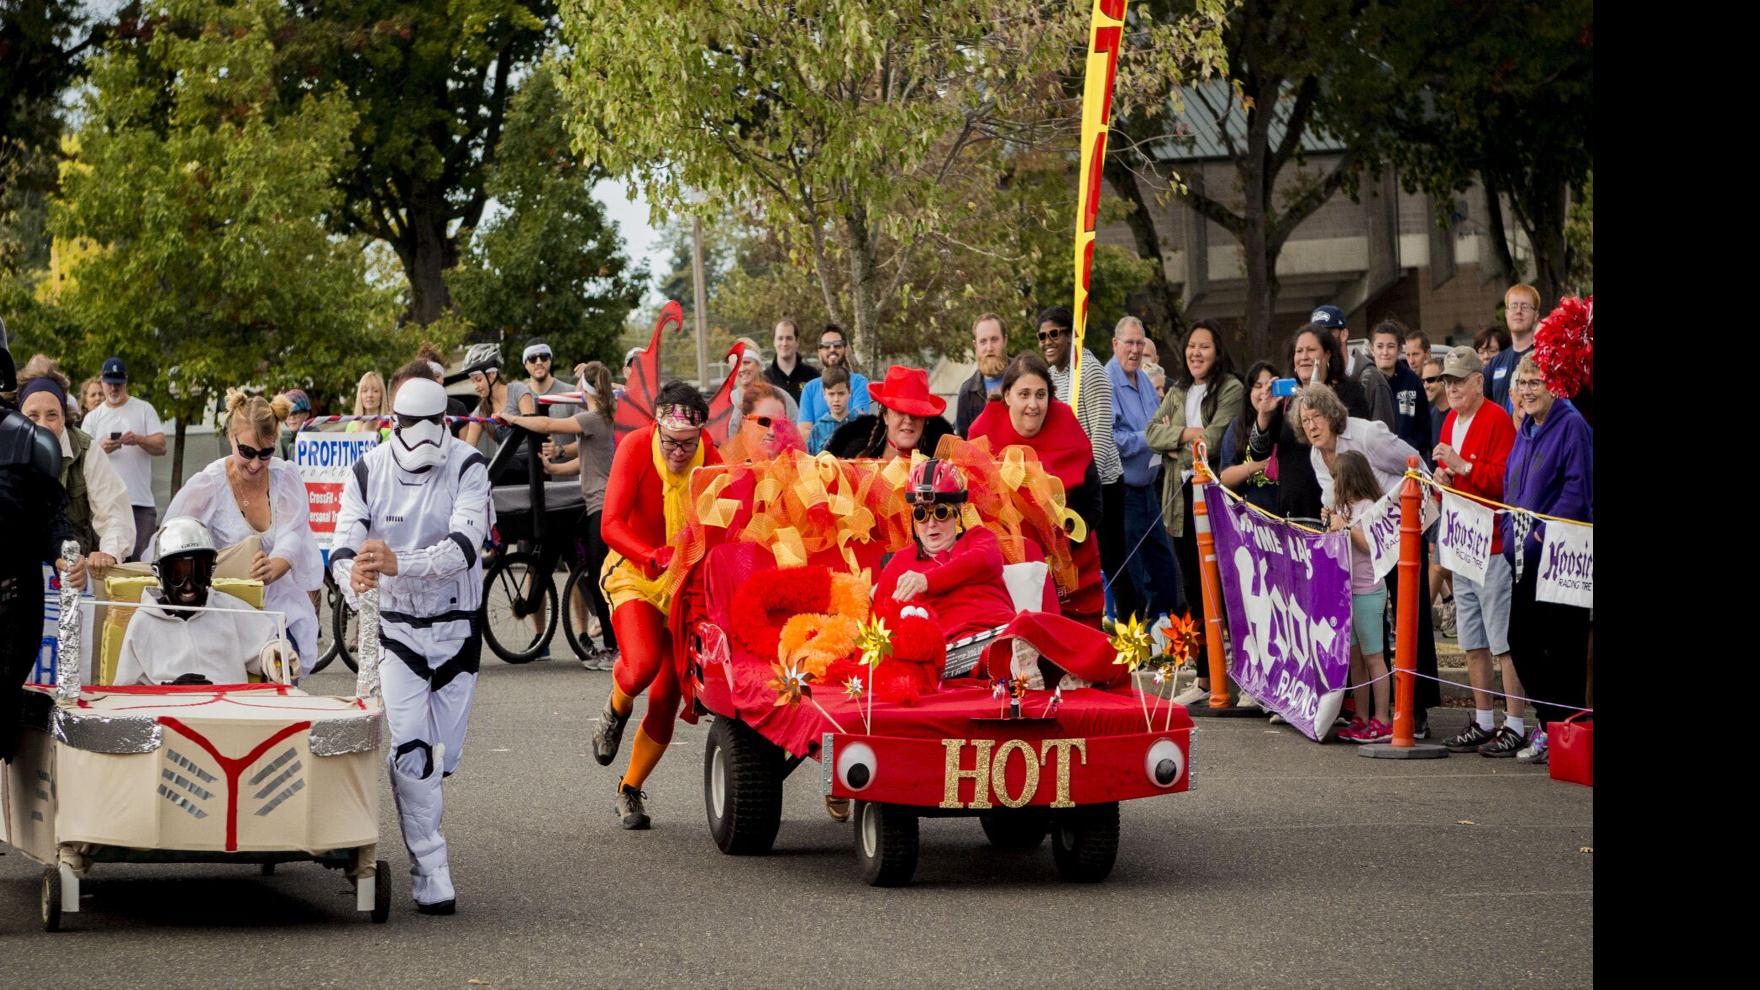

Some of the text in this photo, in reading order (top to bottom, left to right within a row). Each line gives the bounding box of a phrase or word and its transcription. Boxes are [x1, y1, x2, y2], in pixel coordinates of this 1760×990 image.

[309, 510, 331, 523] ersonal
[1442, 509, 1489, 560] Hoosier
[939, 738, 1087, 809] HOT
